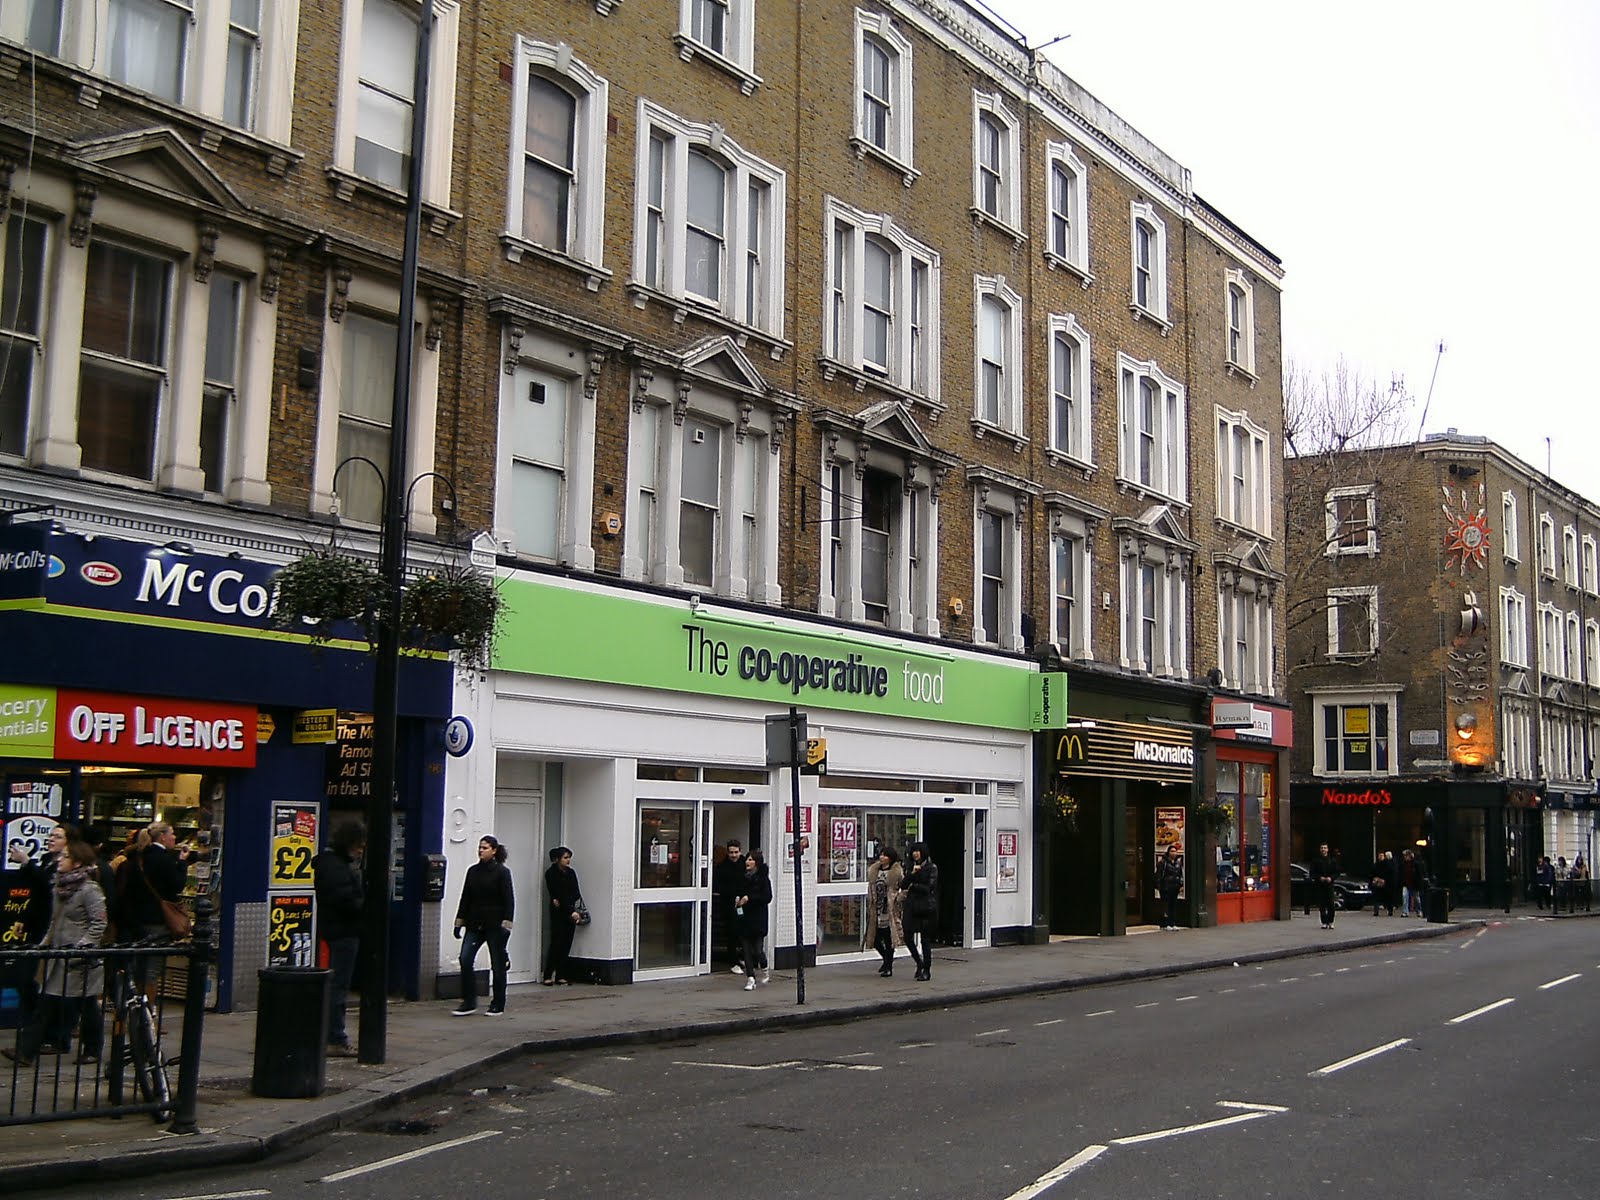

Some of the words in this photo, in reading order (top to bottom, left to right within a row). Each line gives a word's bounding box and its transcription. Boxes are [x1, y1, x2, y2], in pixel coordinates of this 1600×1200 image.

[0, 551, 46, 570] McColl's
[682, 624, 729, 676] The
[739, 646, 888, 697] co-operative
[903, 661, 944, 703] food
[0, 698, 48, 718] cery
[1042, 677, 1051, 725] co-operative
[337, 725, 357, 740] The
[1134, 741, 1194, 765] McDonald's
[341, 763, 356, 777] Ad
[327, 782, 337, 795] in
[340, 781, 358, 795] the
[1321, 788, 1392, 806] Nando's
[9, 793, 49, 814] milk
[37, 825, 50, 834] for
[834, 821, 855, 841] £12
[275, 846, 312, 880] £2
[270, 922, 299, 952] £5
